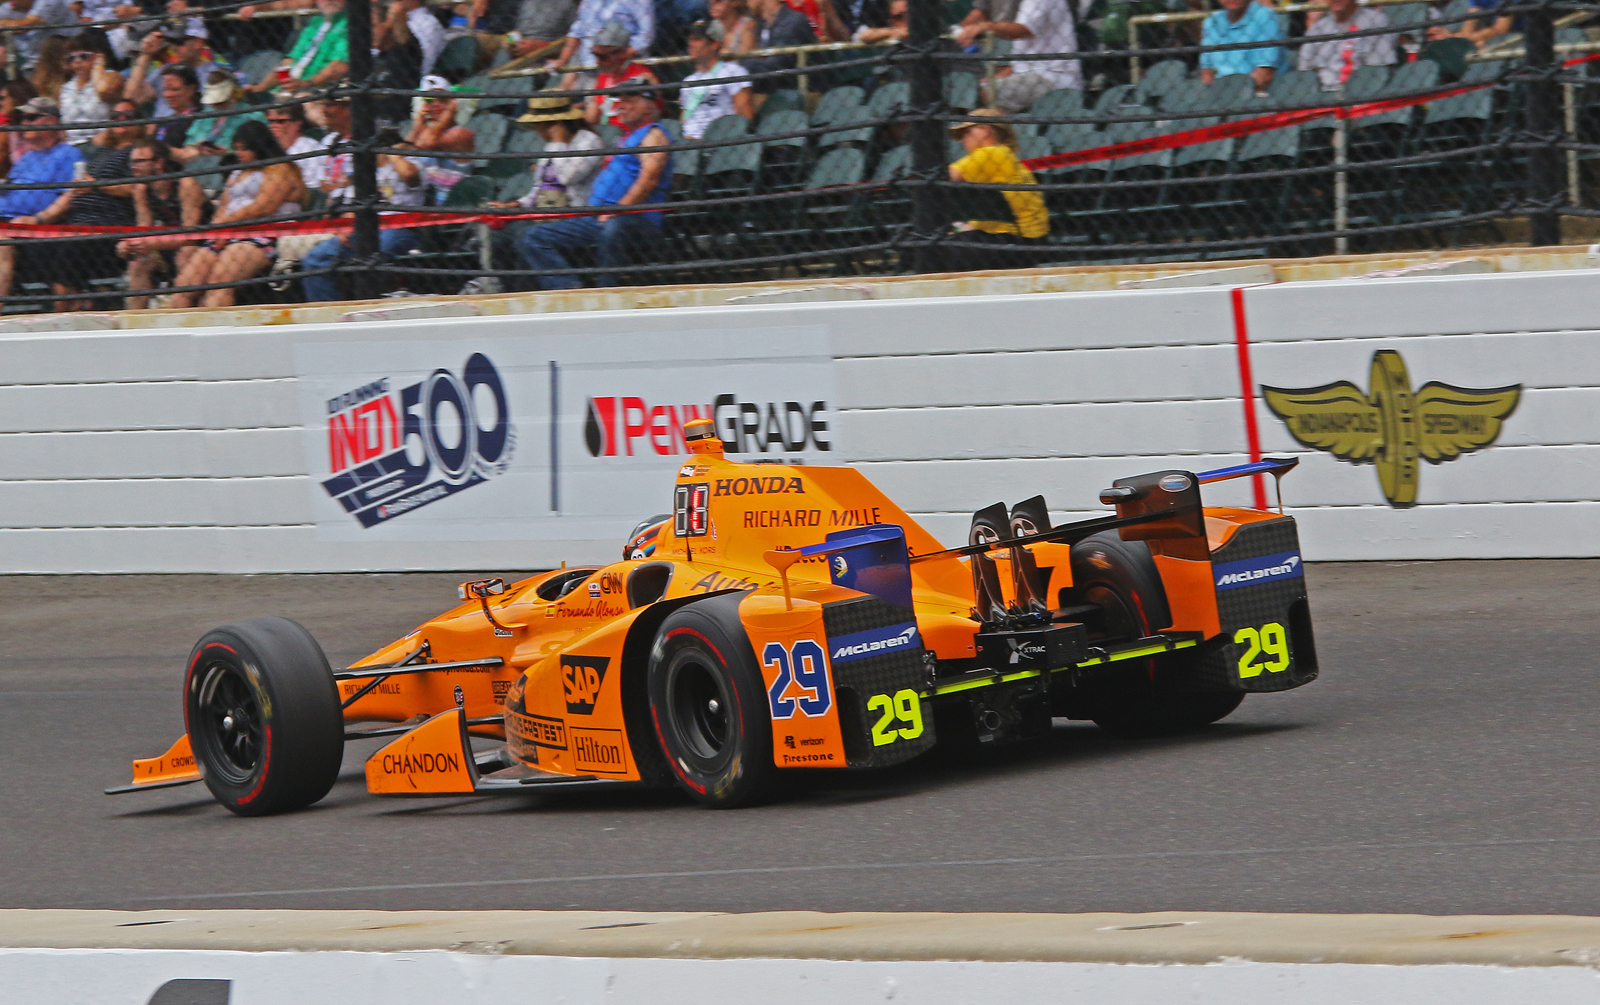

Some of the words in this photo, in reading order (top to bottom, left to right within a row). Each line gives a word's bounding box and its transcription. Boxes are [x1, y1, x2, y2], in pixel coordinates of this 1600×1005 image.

[328, 394, 402, 475] INDY
[400, 353, 509, 483] 500
[713, 476, 805, 497] HONDA
[744, 509, 821, 528] RICHARD
[829, 507, 881, 527] MILLE
[672, 547, 697, 555] MICHEL
[601, 572, 624, 594] CNN
[1216, 562, 1292, 586] McLaren
[557, 601, 595, 618] Fernando
[595, 600, 624, 619] Alonso
[832, 634, 909, 659] McLaren
[1234, 622, 1290, 679] 29
[379, 683, 401, 694] MILLE
[561, 664, 600, 704] SAP
[762, 639, 832, 720] 29
[867, 688, 924, 746] 29
[523, 718, 563, 743] FASTEST
[800, 737, 825, 746] verizon
[574, 736, 622, 764] Hilton
[783, 753, 834, 764] Firestone
[383, 753, 459, 774] CHANDON
